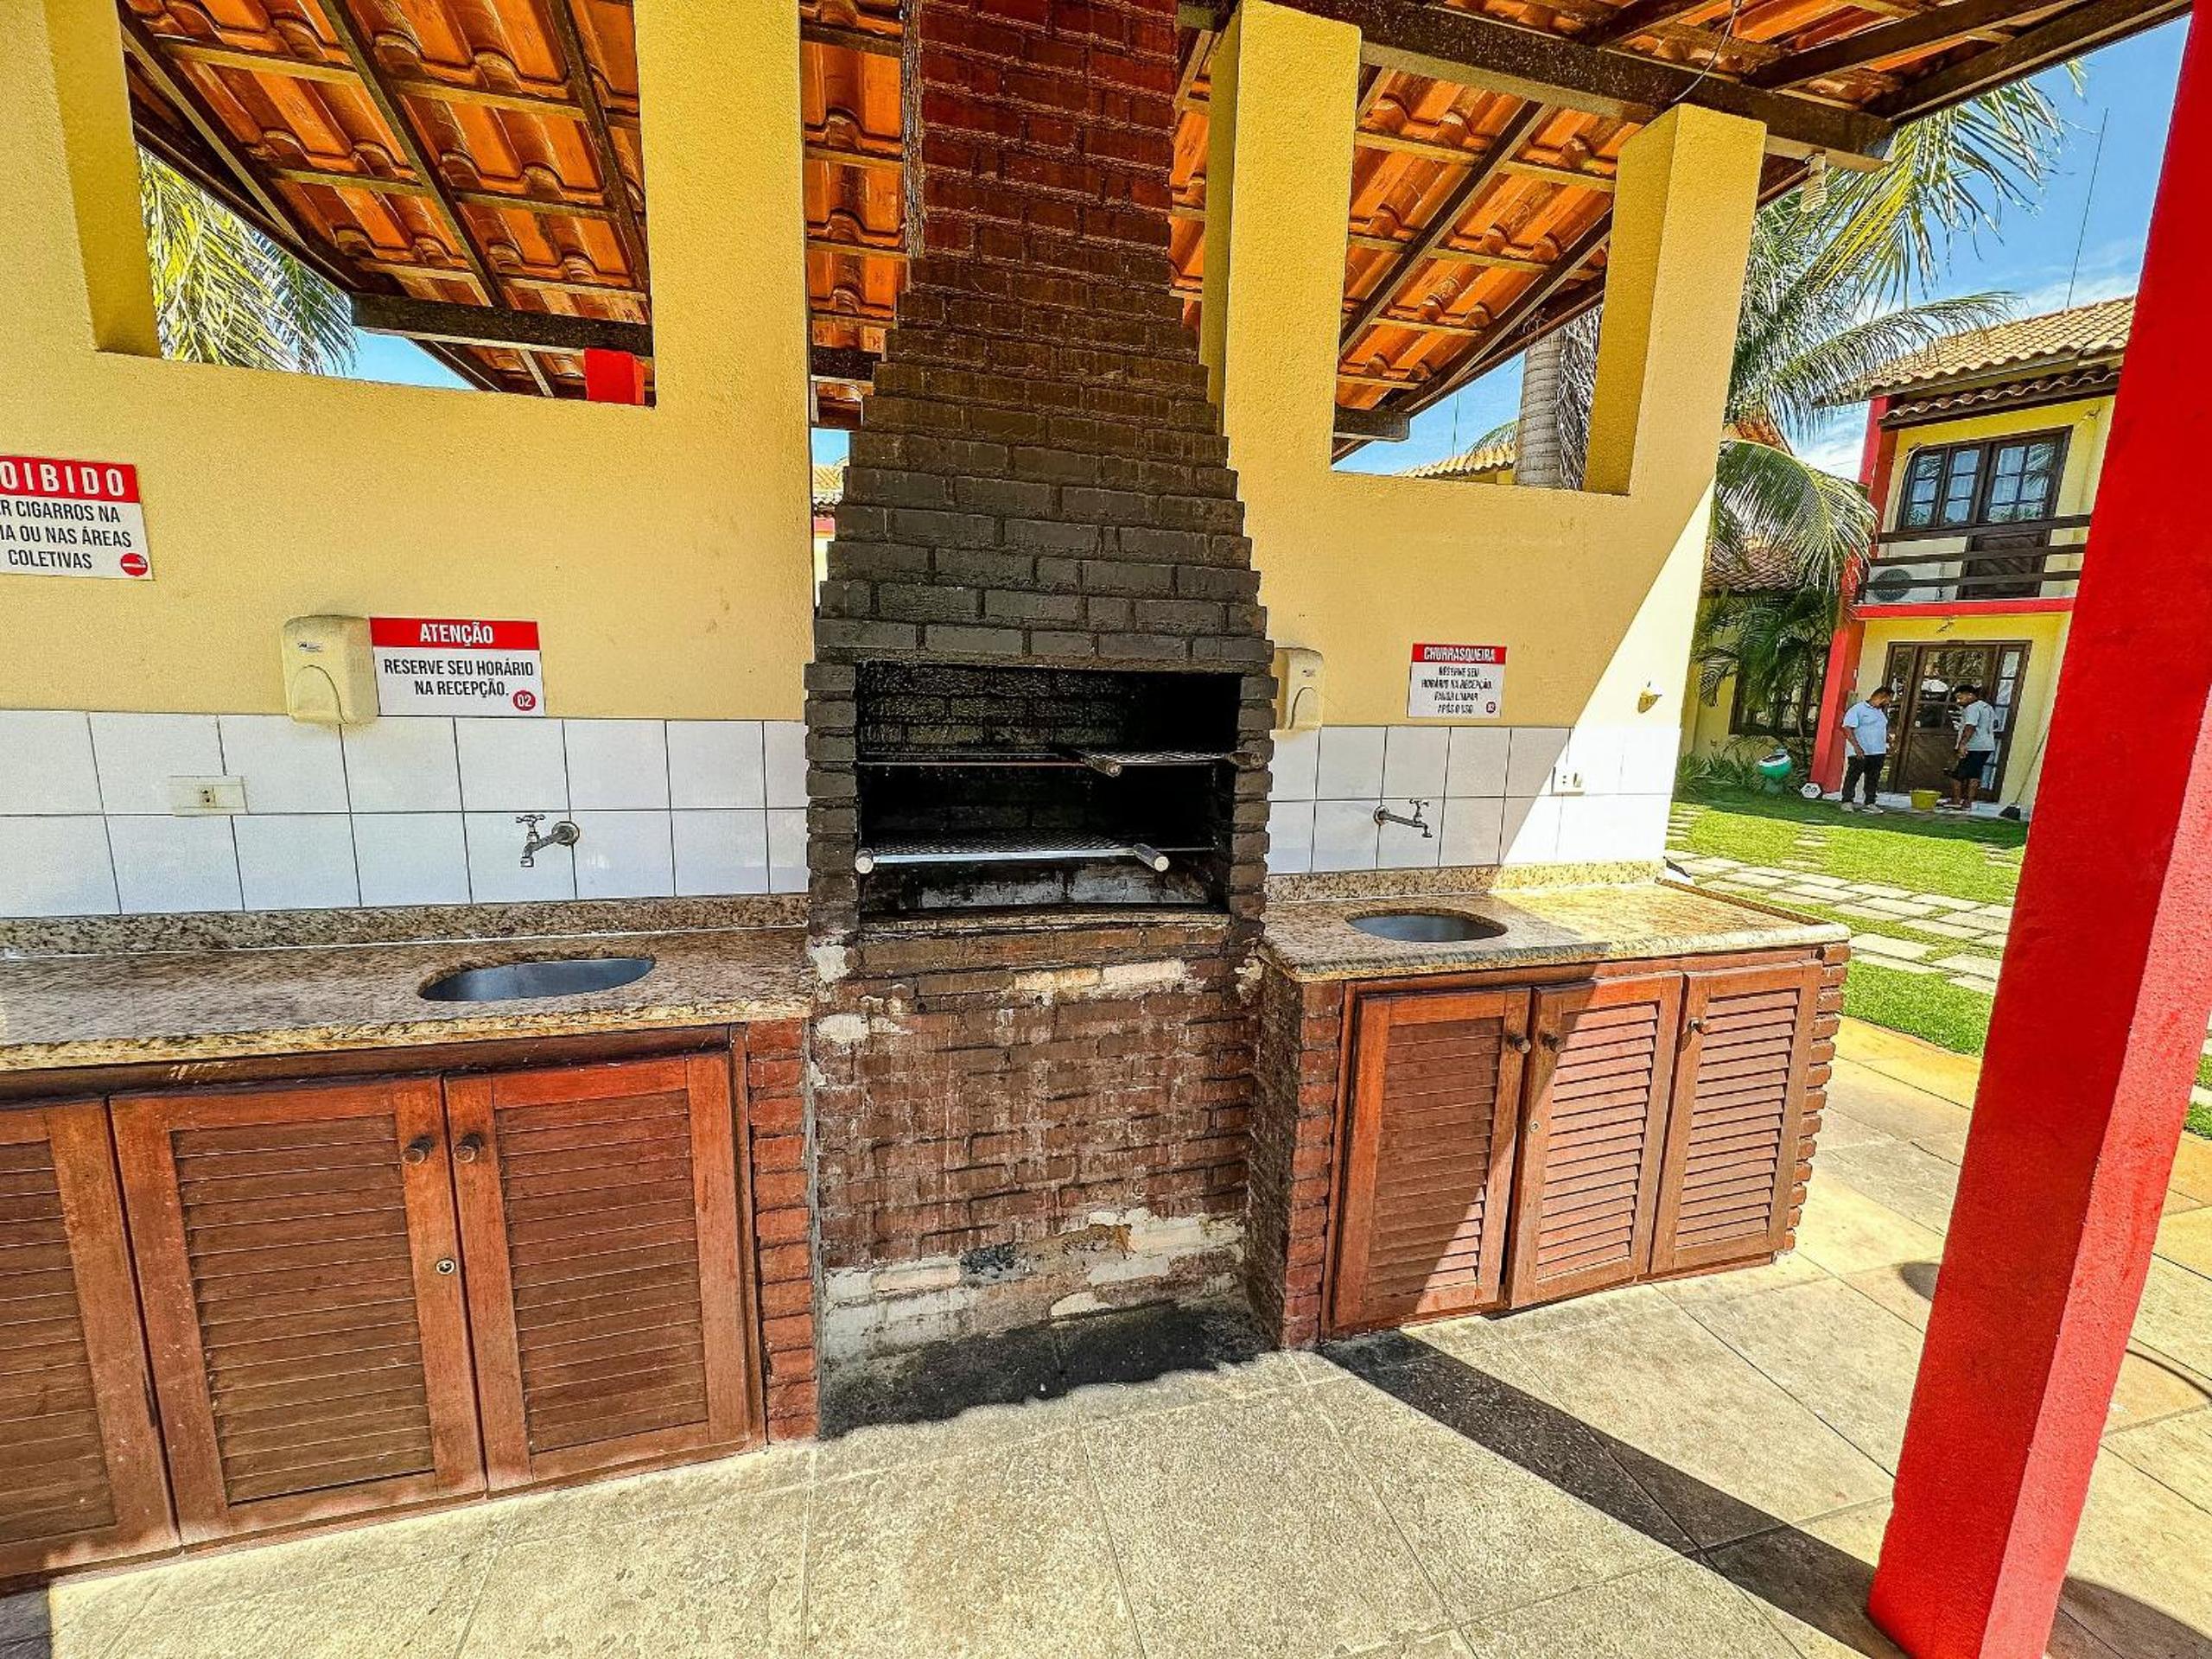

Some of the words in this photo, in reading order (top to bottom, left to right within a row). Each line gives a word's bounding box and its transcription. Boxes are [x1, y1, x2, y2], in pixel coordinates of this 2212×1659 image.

[0, 461, 124, 496] OIBIDO
[0, 500, 12, 517] R
[16, 501, 94, 521] CIGARROS
[99, 505, 120, 523] NA
[20, 525, 41, 542] OU
[46, 527, 77, 544] NAS
[82, 526, 131, 547] ÁREAS
[9, 550, 92, 569] COLETIVAS
[420, 622, 493, 646] ATENÇÃO
[1424, 647, 1495, 662] CHURRASQUEIRA
[384, 659, 444, 675] RESERVE
[448, 660, 473, 675] SEU
[476, 658, 533, 676] HORÁRIO
[415, 681, 434, 696] NA
[437, 678, 509, 698] RECEPÇÃO.
[517, 695, 531, 707] 02
